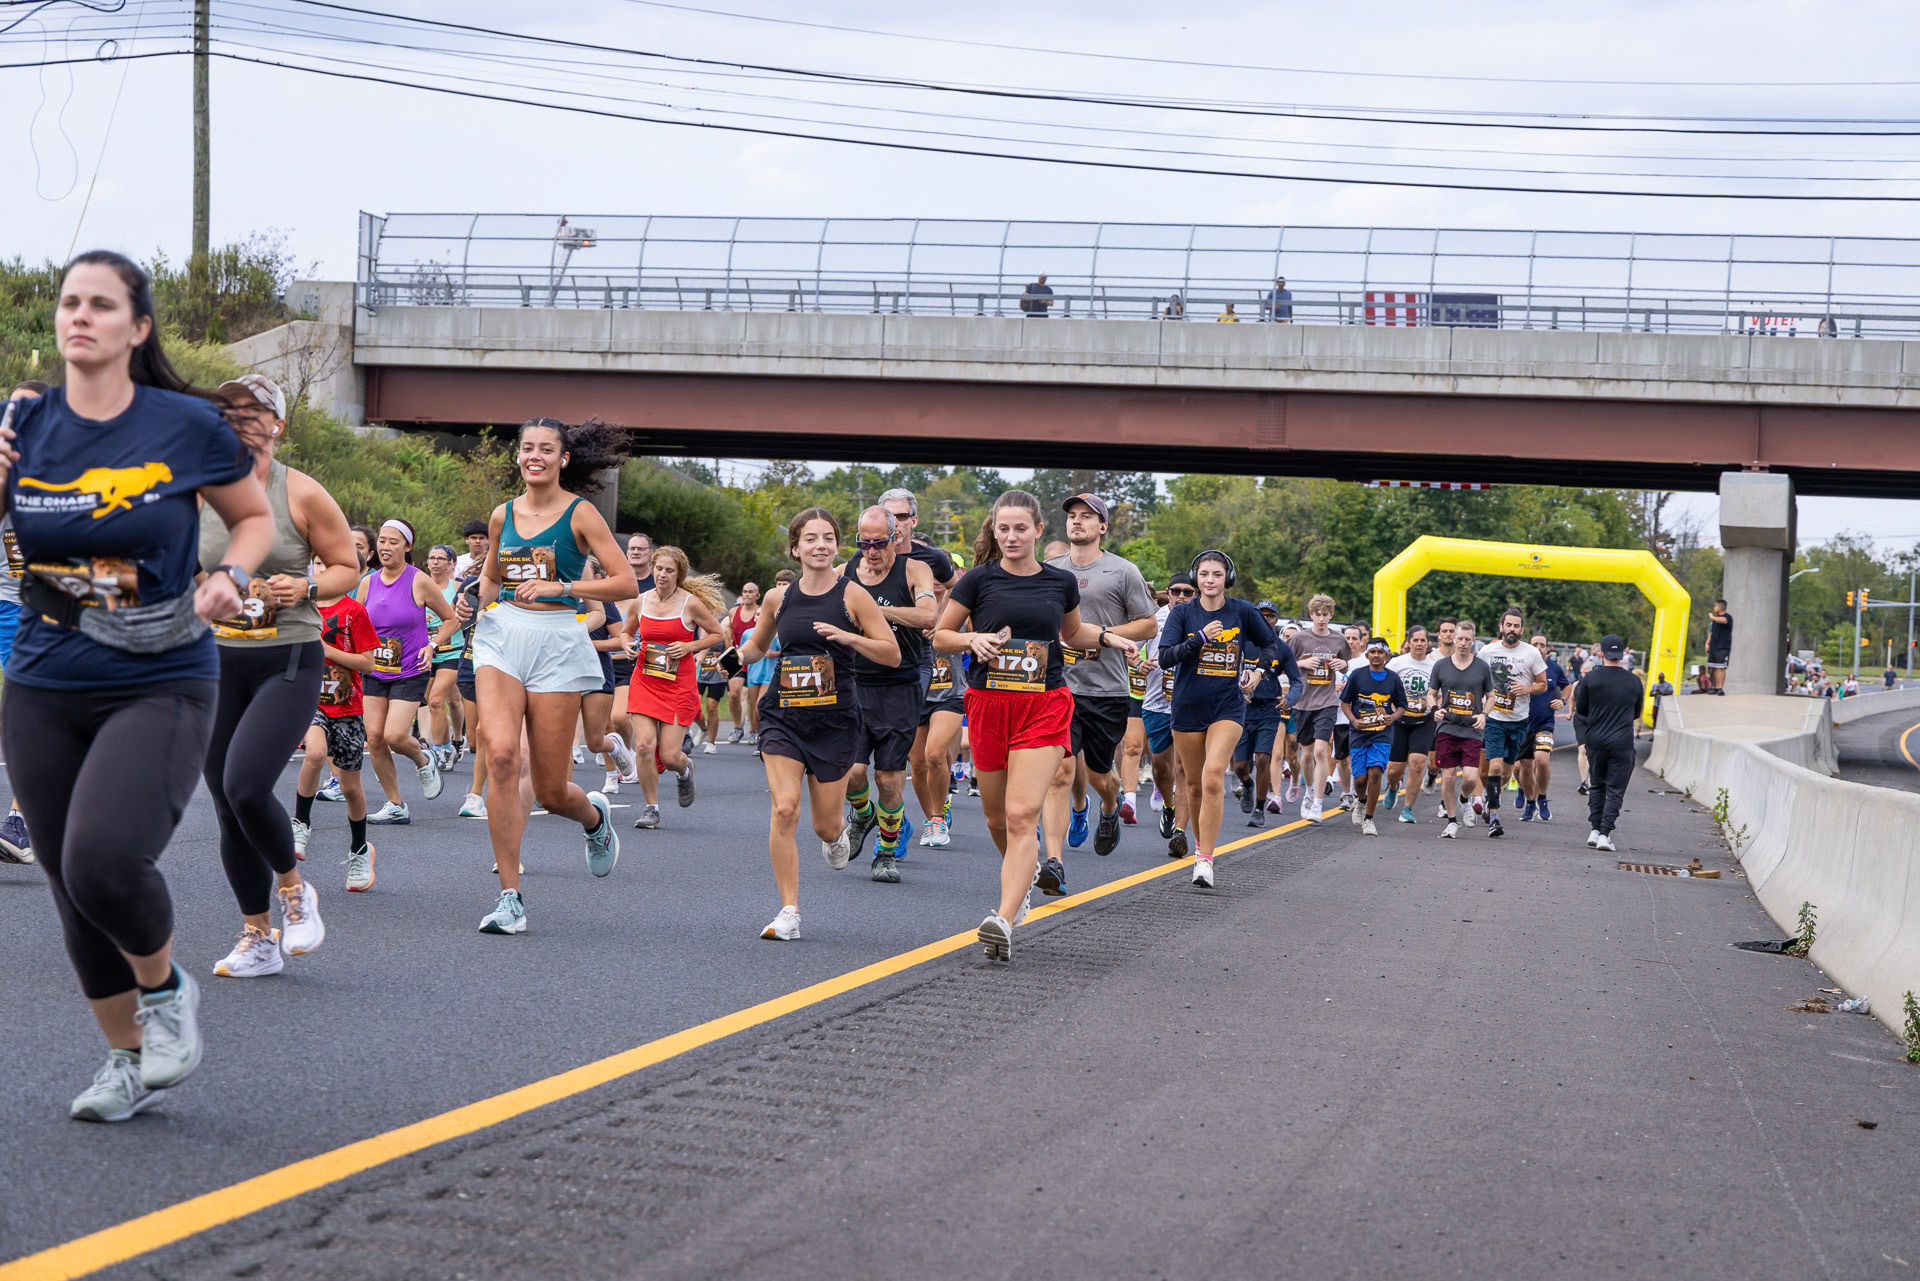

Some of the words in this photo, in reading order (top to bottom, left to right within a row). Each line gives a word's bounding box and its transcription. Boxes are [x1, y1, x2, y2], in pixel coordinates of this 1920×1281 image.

[15, 494, 42, 506] THE
[507, 564, 547, 579] 221
[997, 655, 1038, 672] 170
[1202, 652, 1236, 664] 268
[789, 672, 822, 688] 171
[1131, 677, 1147, 687] 13
[1452, 697, 1472, 707] 160
[1362, 714, 1385, 724] 274
